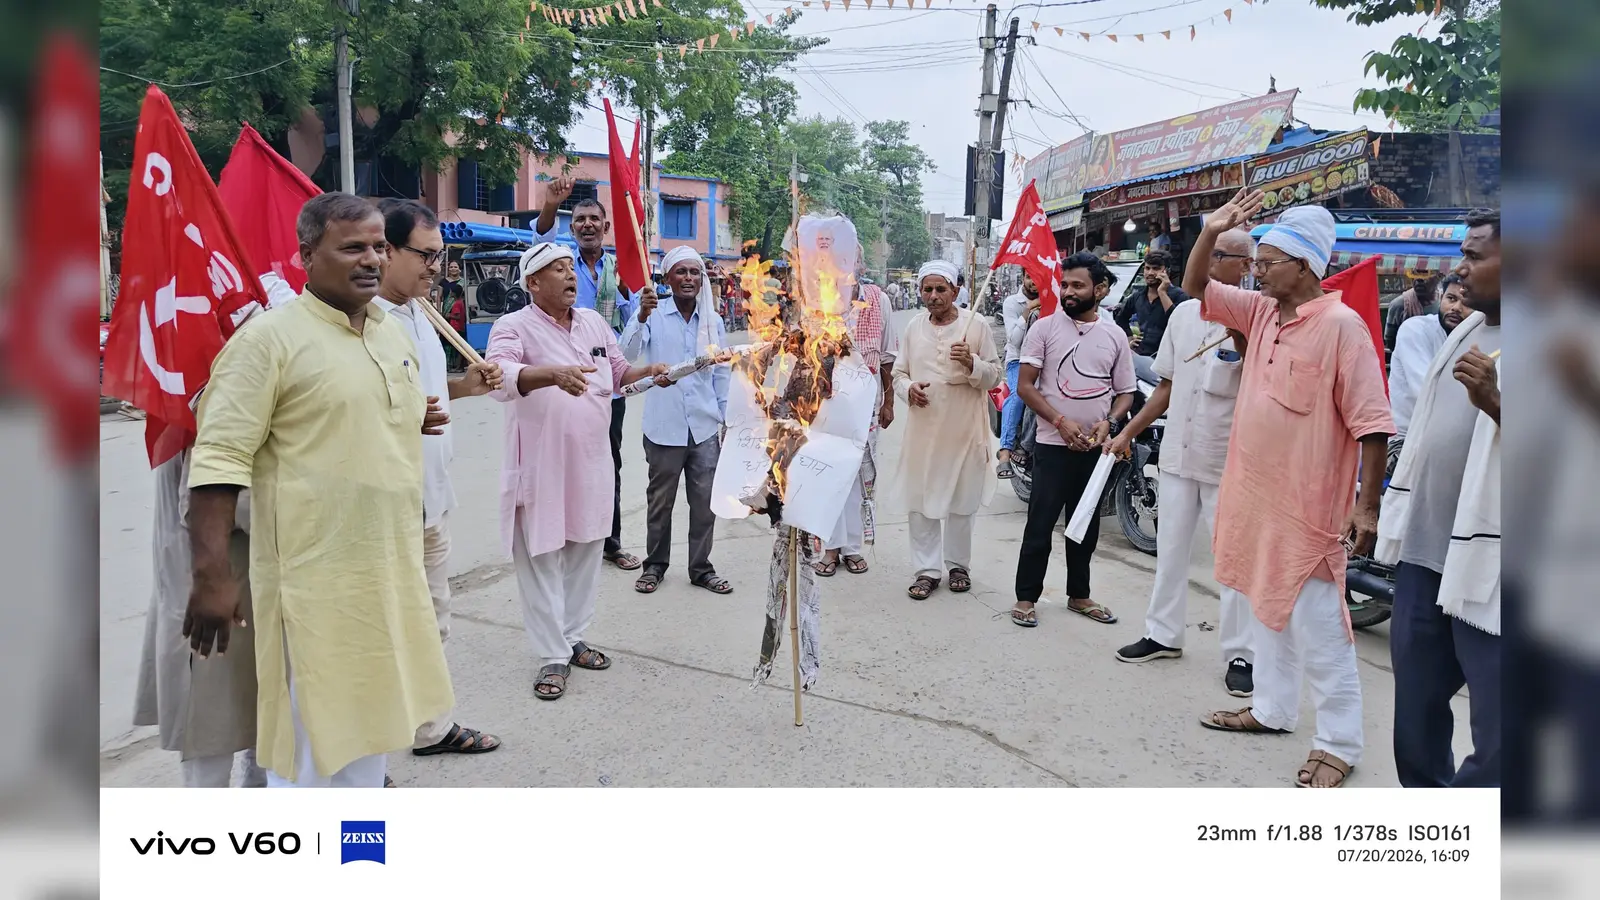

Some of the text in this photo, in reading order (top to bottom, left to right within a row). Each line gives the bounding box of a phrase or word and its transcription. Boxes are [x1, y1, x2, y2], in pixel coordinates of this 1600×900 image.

[1252, 157, 1300, 184] BLUE
[1300, 139, 1365, 170] MOON
[1354, 226, 1454, 239] CITY LIFE
